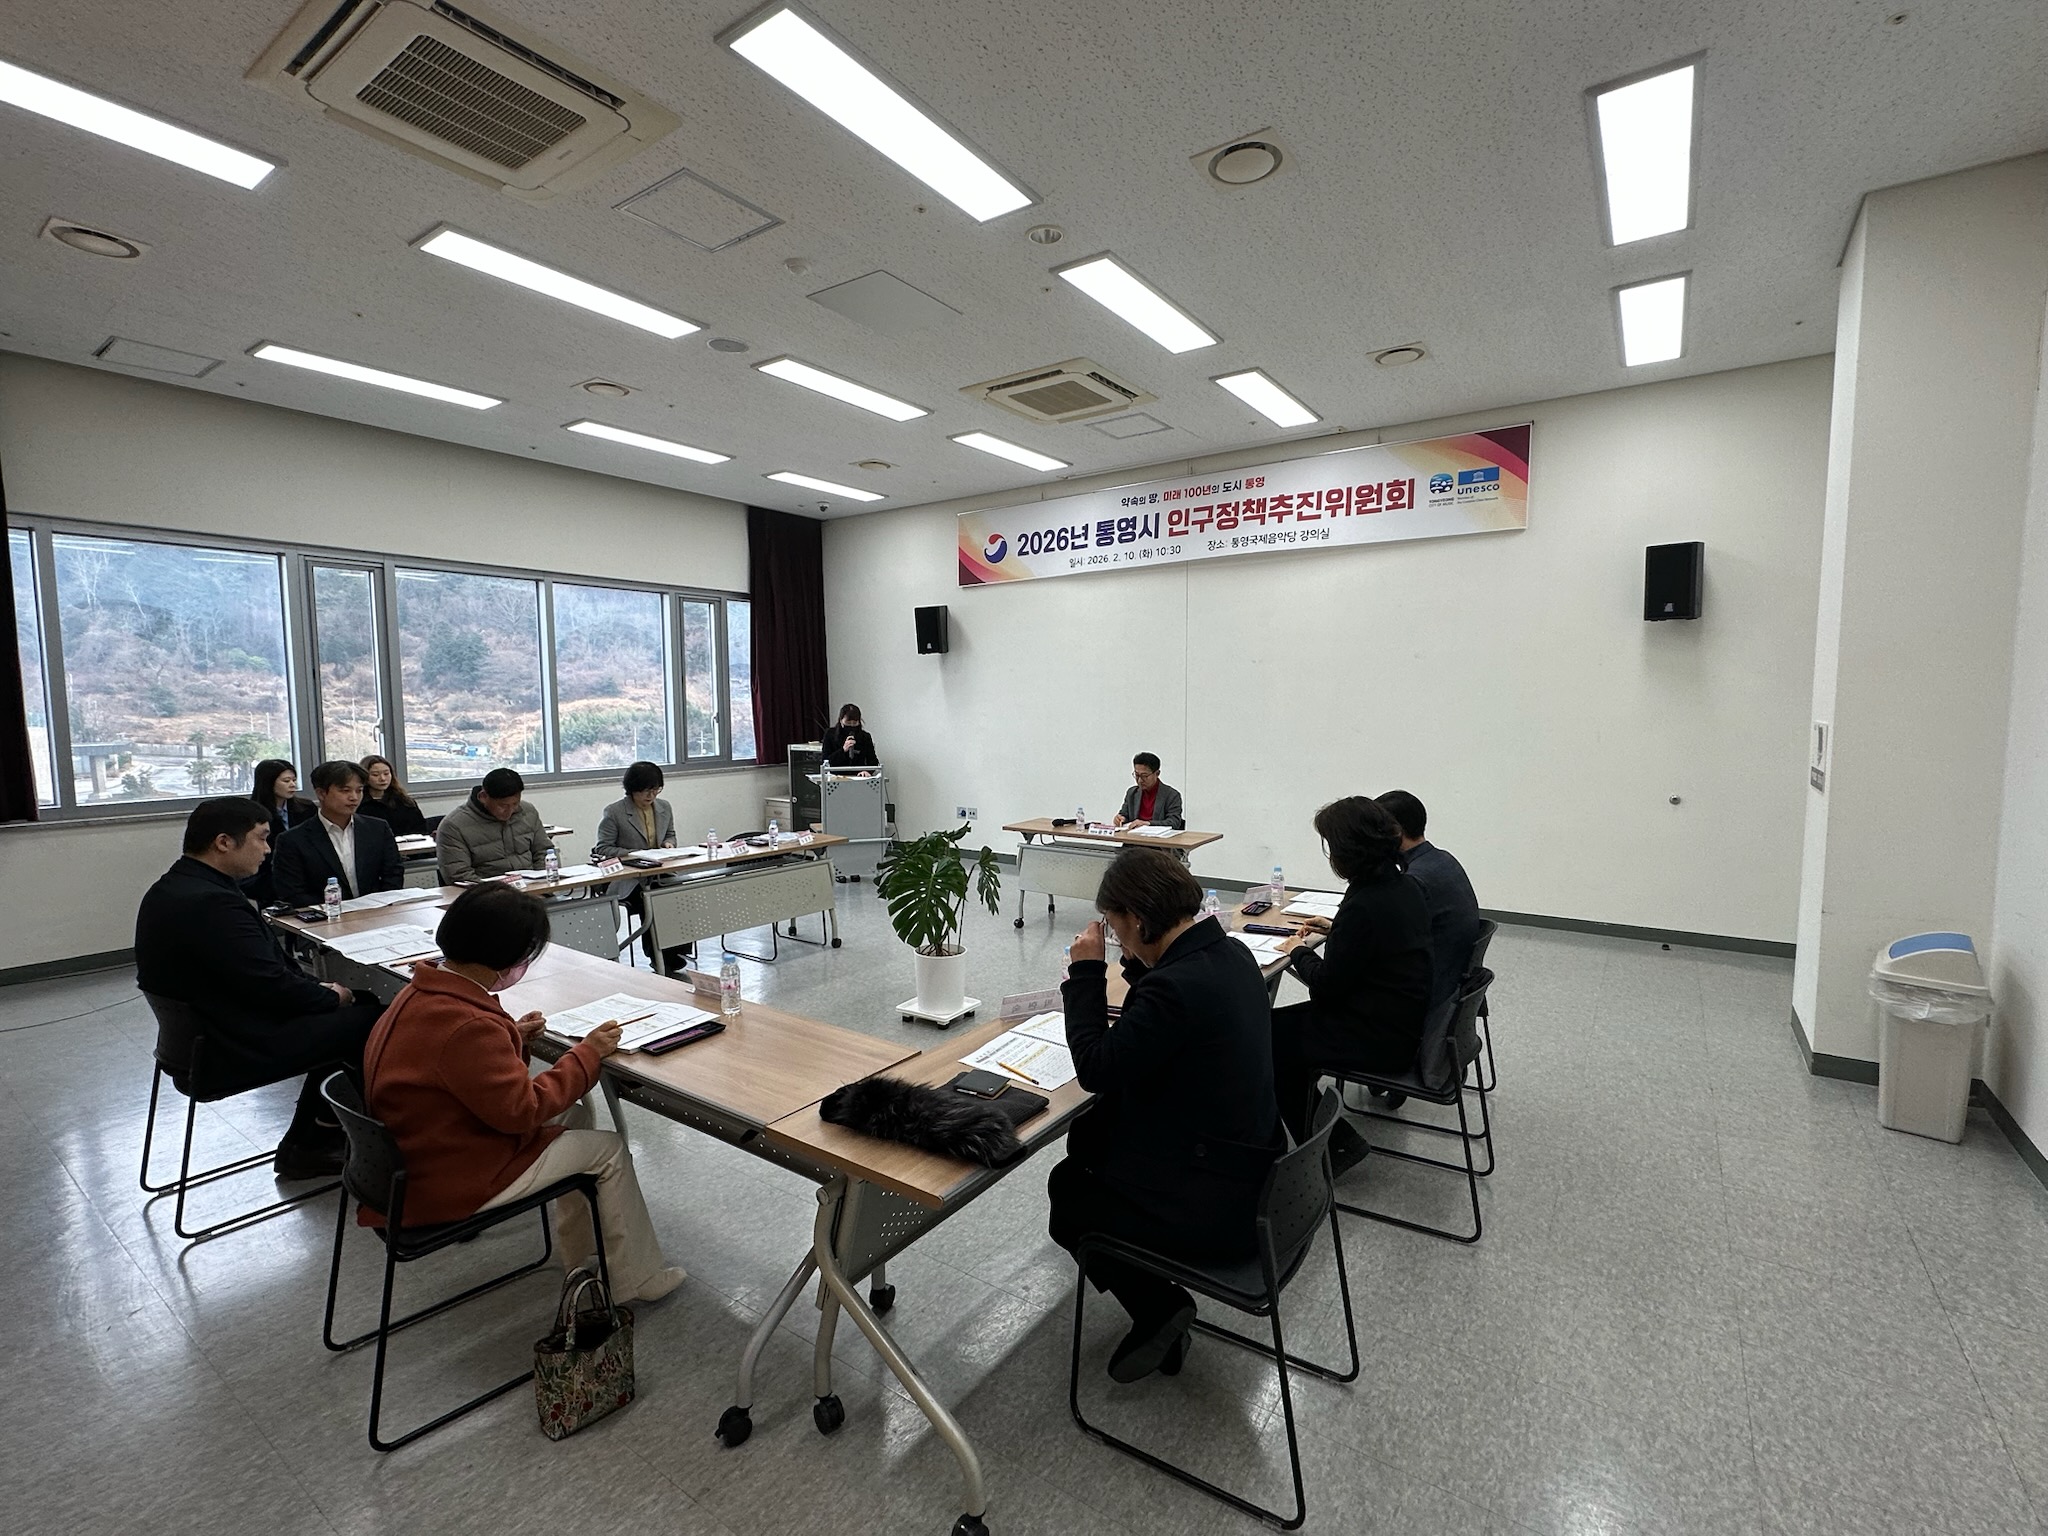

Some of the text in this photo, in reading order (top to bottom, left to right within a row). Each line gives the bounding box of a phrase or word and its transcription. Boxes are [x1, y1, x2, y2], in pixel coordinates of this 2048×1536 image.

[1121, 496, 1146, 507] 약속의
[1163, 489, 1181, 502] 미래
[1184, 484, 1220, 498] 100년의
[1222, 479, 1242, 493] 도시
[1245, 476, 1265, 489] 통영
[1458, 484, 1499, 495] unesco
[1017, 478, 1416, 557] 2026년 통영시 인구정책추진위원회
[1231, 530, 1297, 549] 통영국제음악당
[1300, 527, 1330, 541] 강의실
[1139, 548, 1153, 559] (화)
[1156, 545, 1182, 556] 10:30
